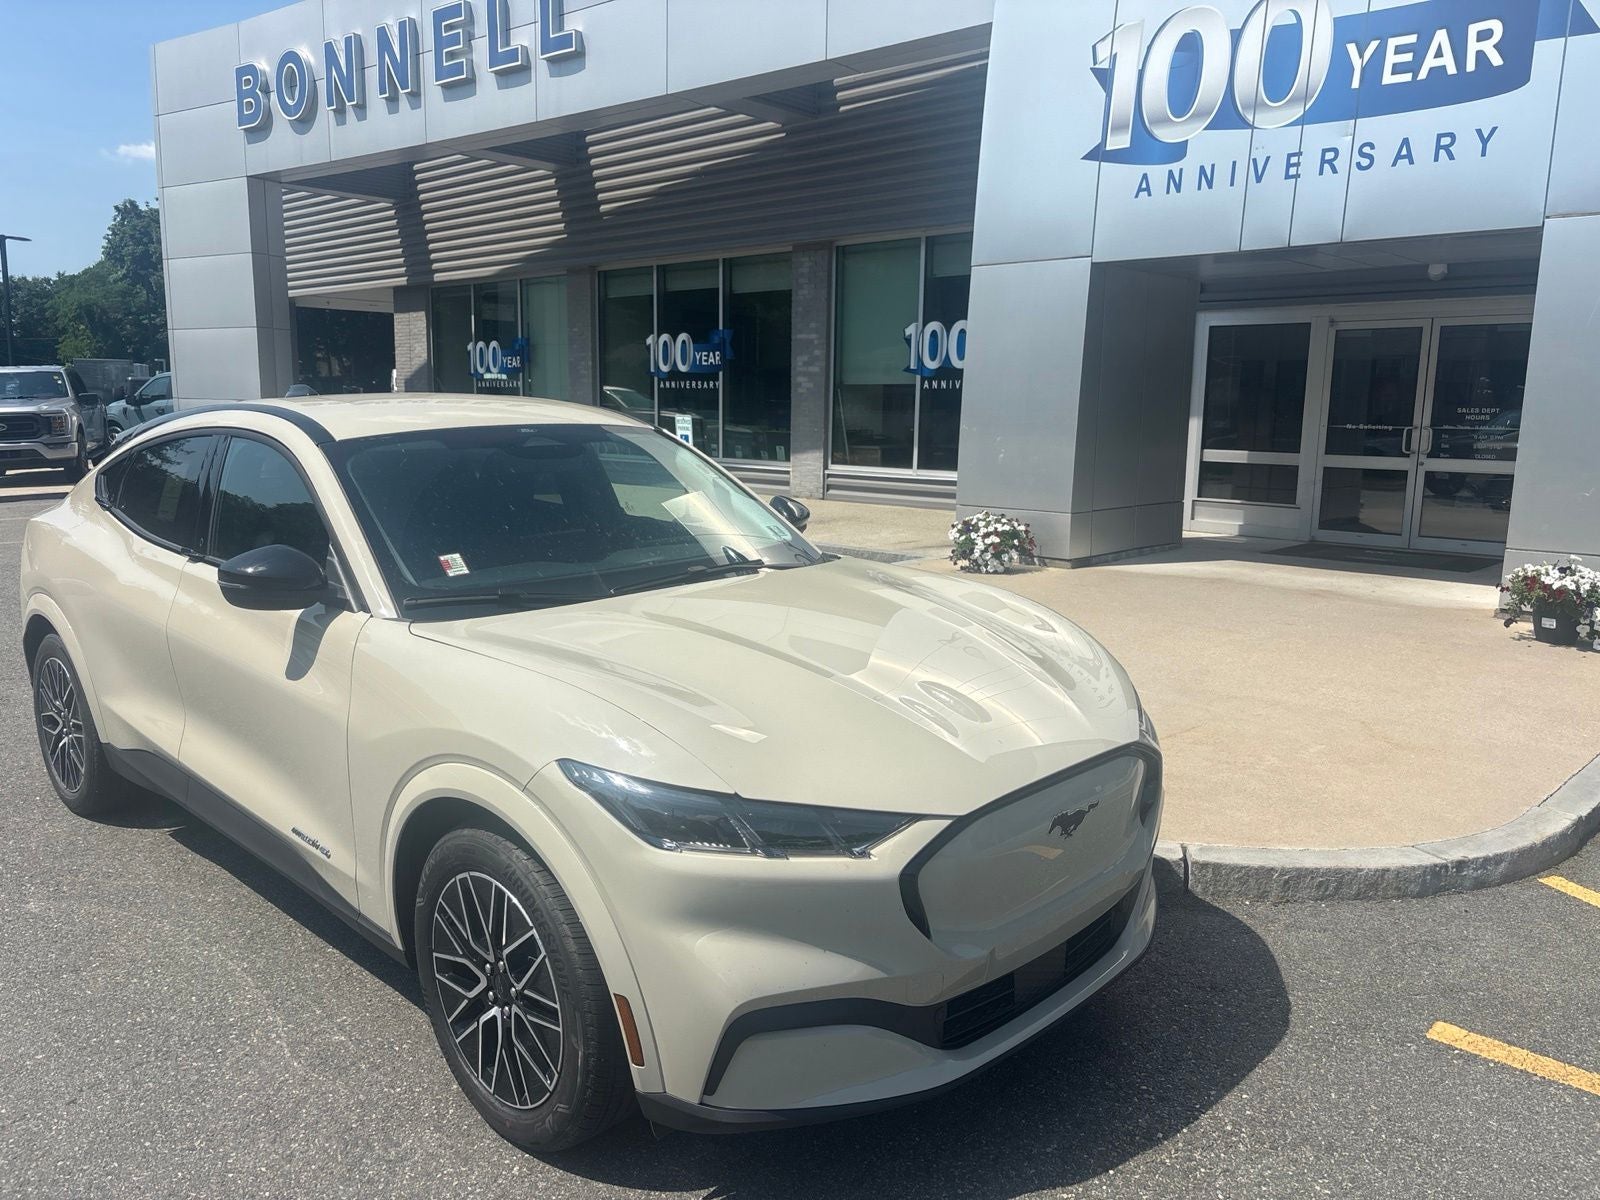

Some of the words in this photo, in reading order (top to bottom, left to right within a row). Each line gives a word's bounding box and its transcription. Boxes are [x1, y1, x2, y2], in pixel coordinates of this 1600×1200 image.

[234, 0, 584, 130] BONNELL
[1091, 0, 1335, 151] 100
[1345, 18, 1504, 89] YEAR
[1134, 126, 1499, 198] ANNIVERSARY
[466, 340, 502, 374] 100
[502, 356, 521, 368] YEAR
[646, 332, 694, 373] 100
[695, 351, 721, 365] YEAR
[903, 320, 968, 369] 100
[660, 380, 720, 389] ANNIVERSARY
[923, 379, 961, 389] ANNIV
